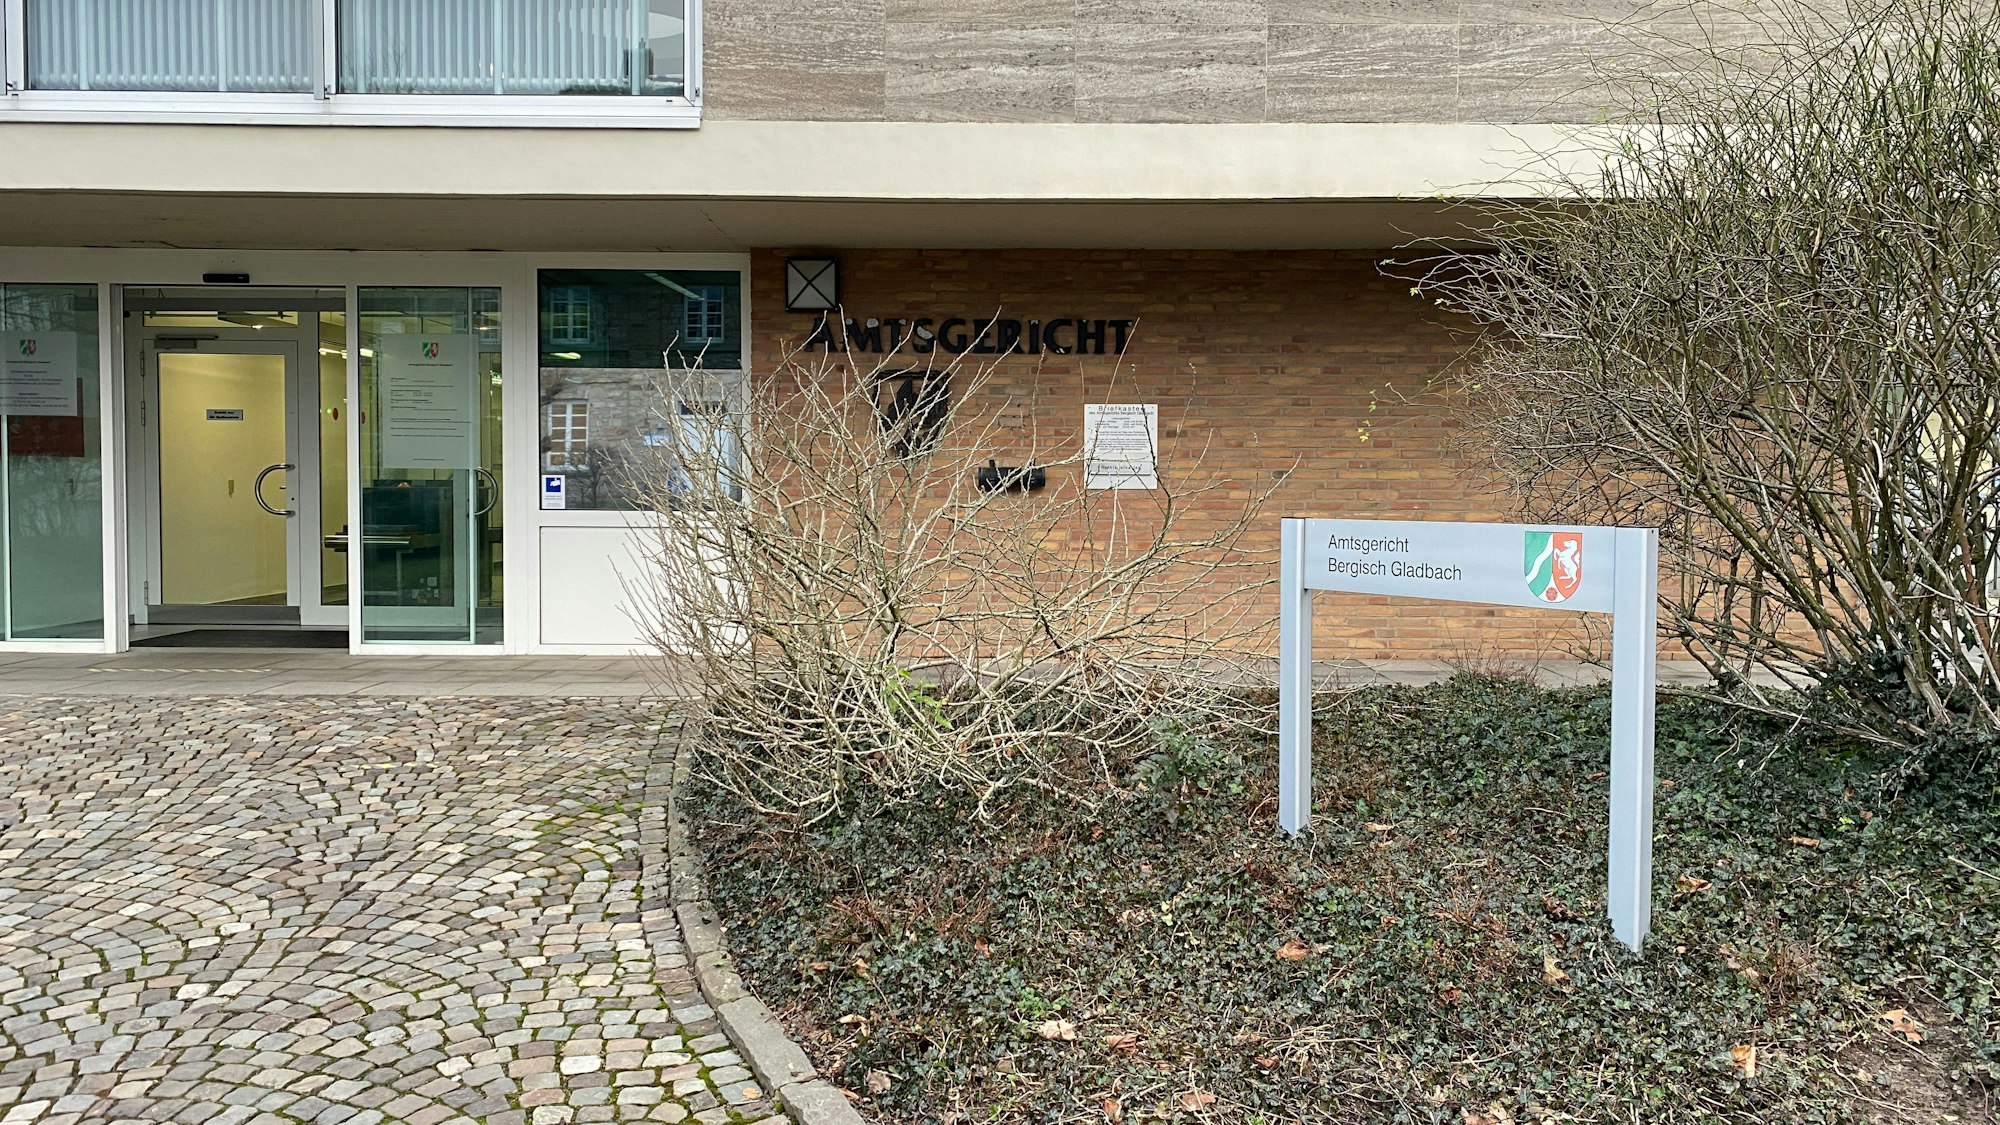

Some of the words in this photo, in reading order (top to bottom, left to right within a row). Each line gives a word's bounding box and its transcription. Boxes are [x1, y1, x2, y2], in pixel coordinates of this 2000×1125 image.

[806, 317, 1133, 356] AMTSGERICHT
[1328, 534, 1409, 555] Amtsgericht
[1328, 557, 1386, 578] Bergisch
[1391, 561, 1462, 581] Gladbach
